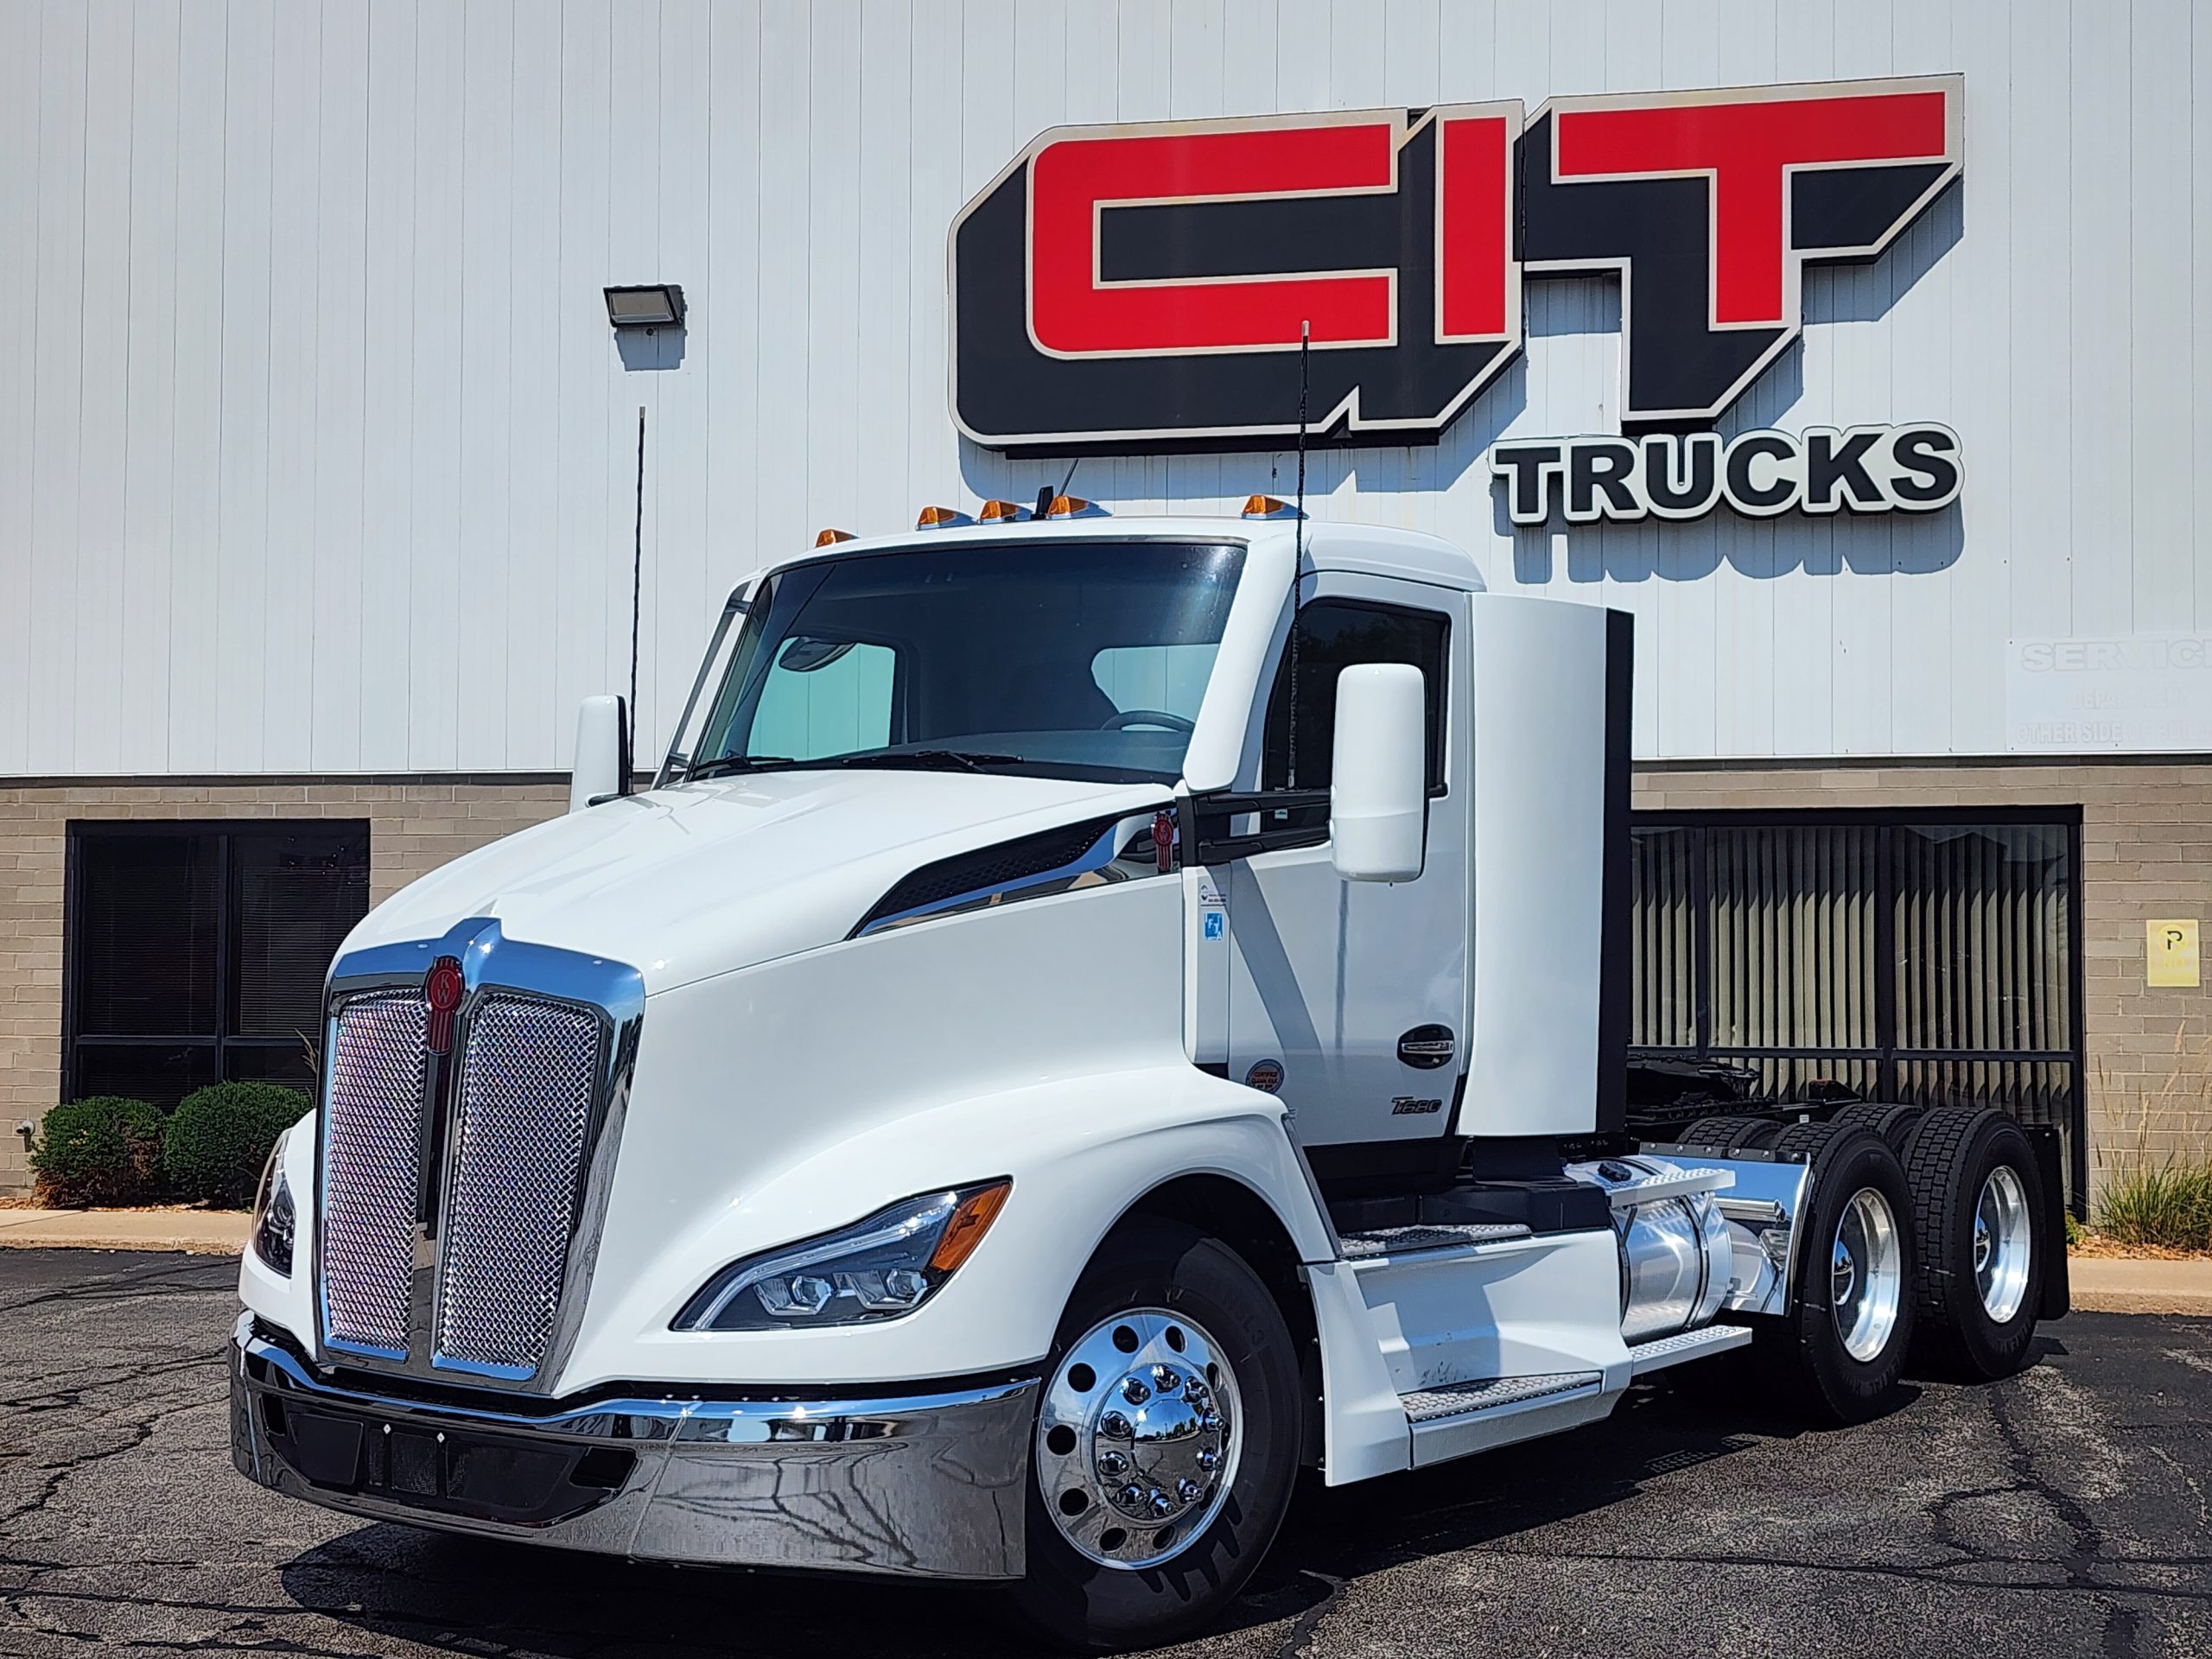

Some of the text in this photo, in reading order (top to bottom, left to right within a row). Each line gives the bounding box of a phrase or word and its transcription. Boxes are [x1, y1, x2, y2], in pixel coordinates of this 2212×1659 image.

[1020, 79, 1960, 359] CIT
[1493, 429, 1959, 516] TRUCKS
[2020, 639, 2212, 672] SERVIC
[2080, 721, 2124, 743] SIDE
[1391, 1096, 1443, 1116] T680
